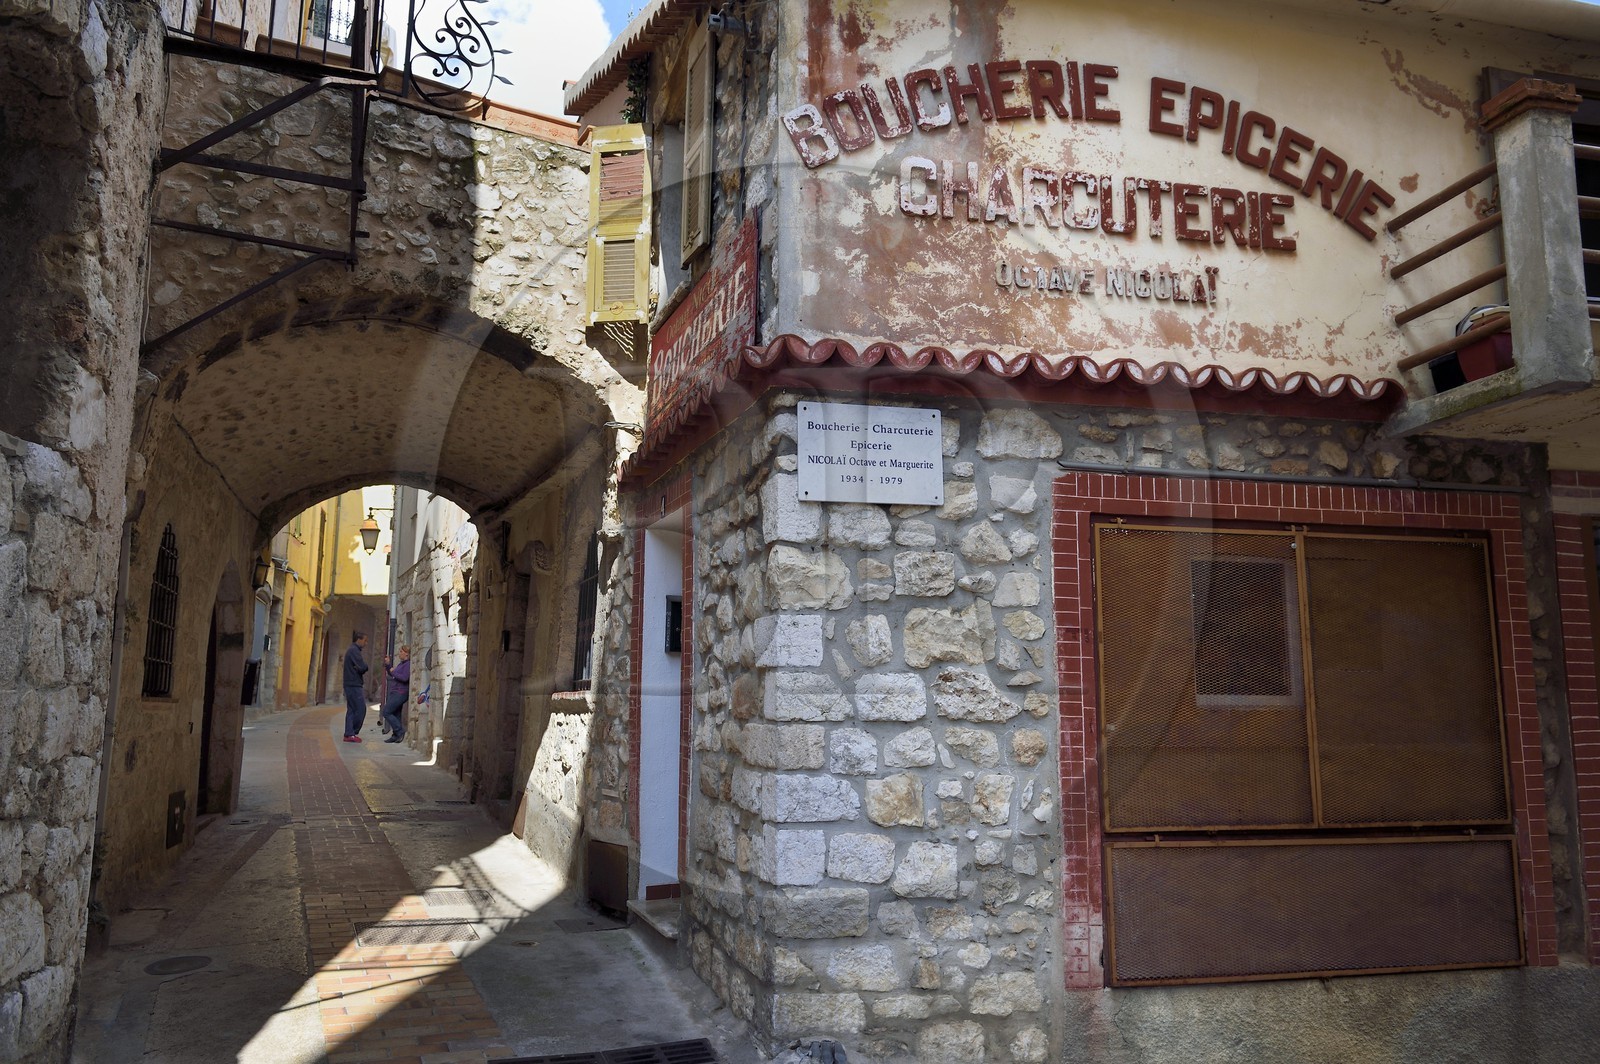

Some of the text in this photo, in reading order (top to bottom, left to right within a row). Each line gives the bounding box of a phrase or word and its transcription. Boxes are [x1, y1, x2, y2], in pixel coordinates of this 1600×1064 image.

[781, 60, 1396, 241] BOUCHERIE EPICERIE
[900, 156, 1297, 252] CHARCUTERIE
[995, 260, 1096, 294] OCTAVE
[807, 421, 860, 432] Boucherie
[873, 424, 933, 435] Charcuterie
[850, 440, 892, 451] Epicerie
[807, 454, 934, 471] NICOLAÏ Octave et Marguerite
[840, 474, 864, 483] 1934
[879, 476, 903, 485] 1979
